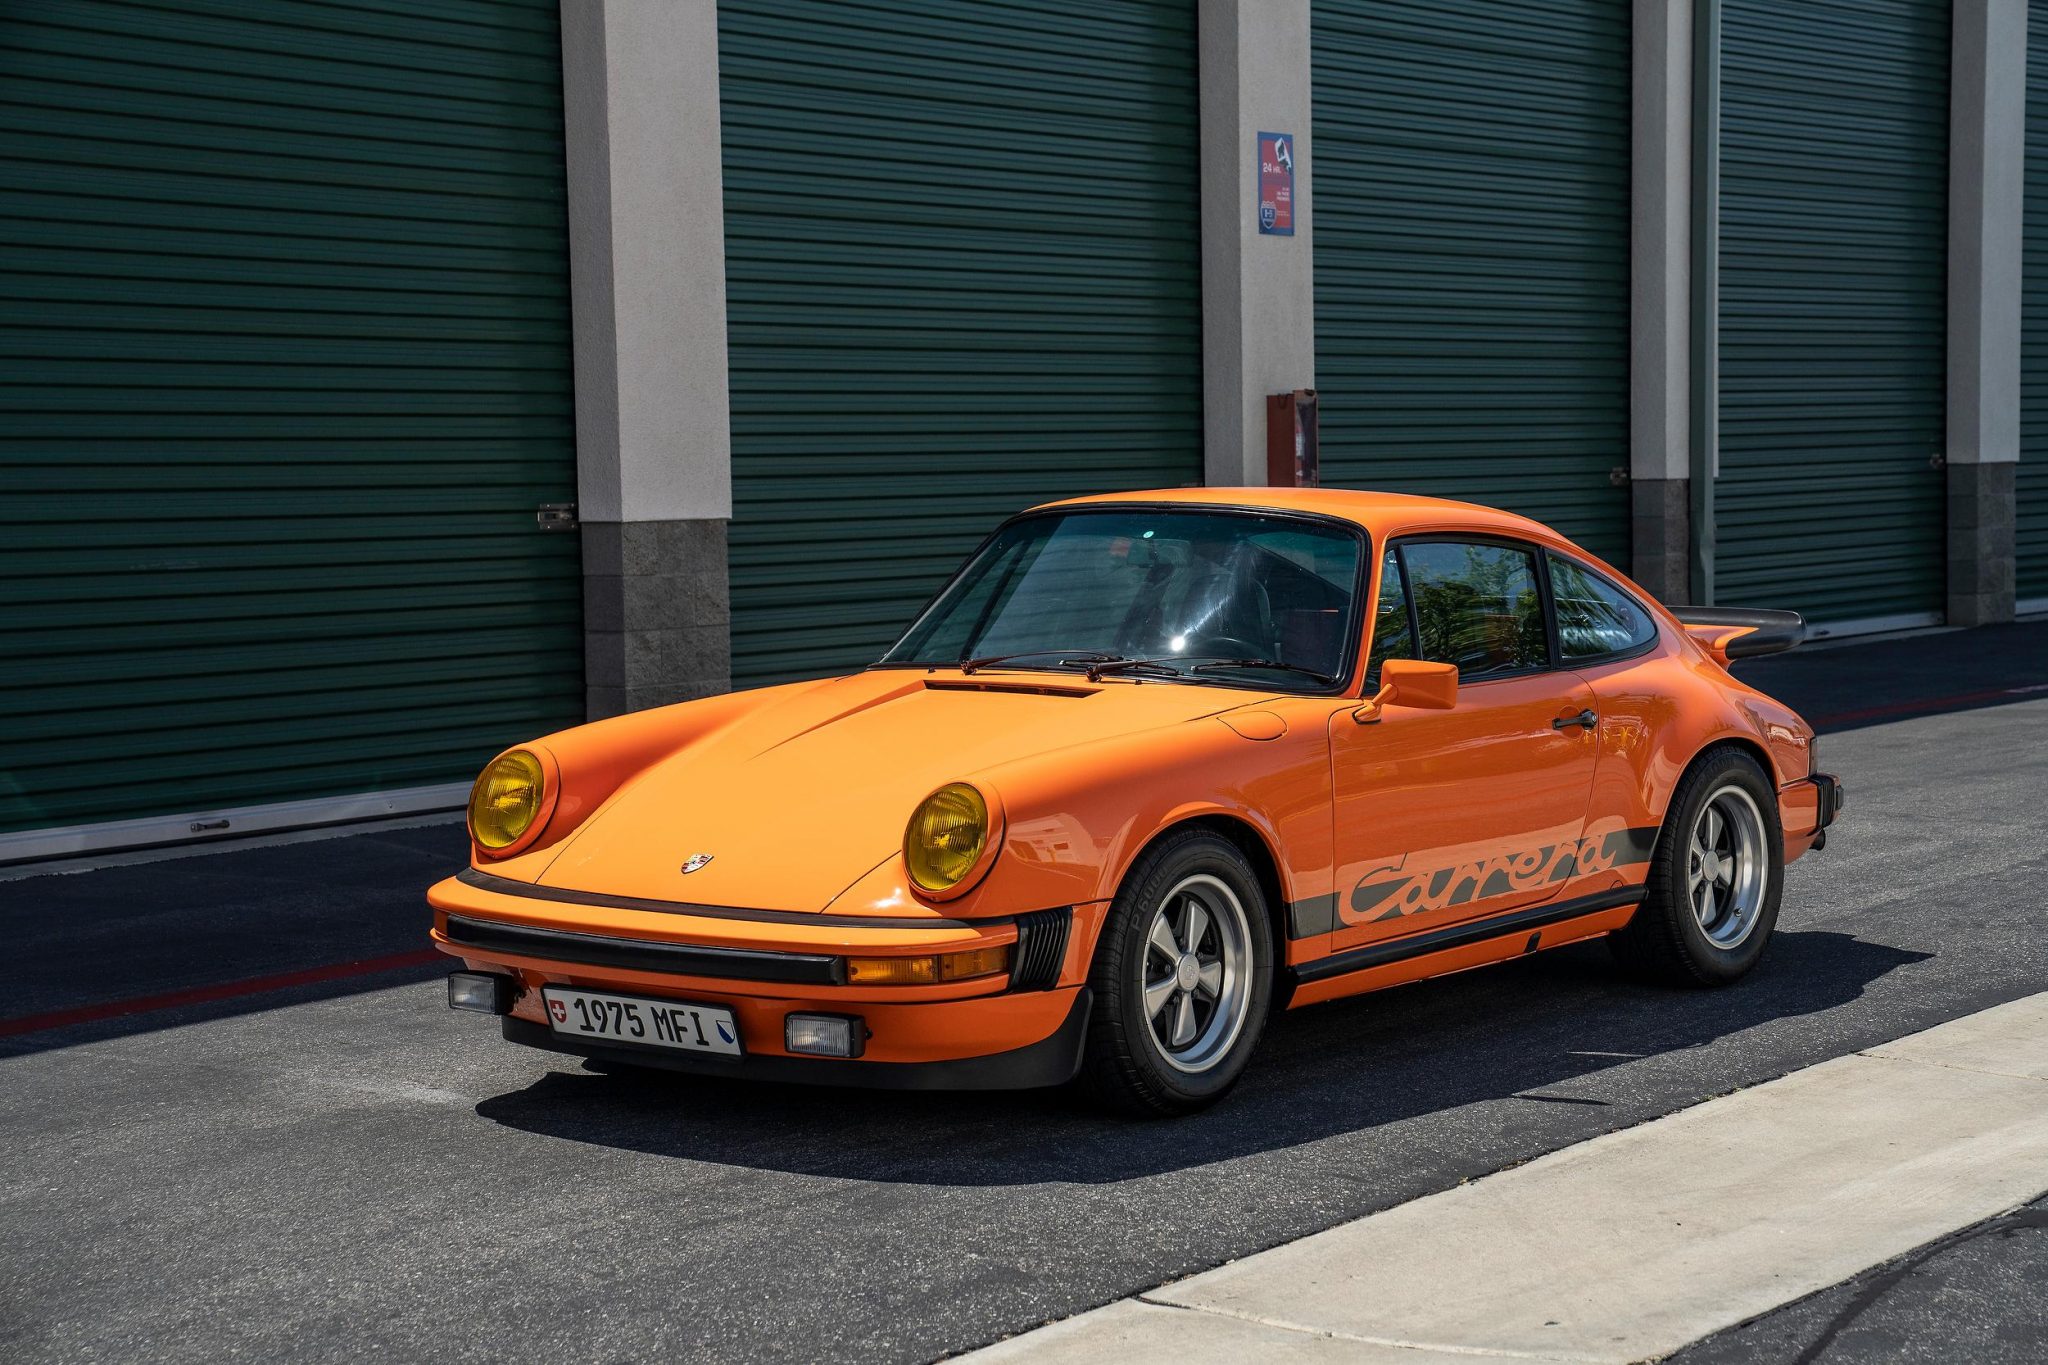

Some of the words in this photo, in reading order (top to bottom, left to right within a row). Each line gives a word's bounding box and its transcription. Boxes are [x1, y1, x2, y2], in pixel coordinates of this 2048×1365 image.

[1263, 162, 1272, 173] 24
[1338, 832, 1617, 926] Carrera
[574, 998, 645, 1038] 1975
[650, 1006, 710, 1046] MFI
